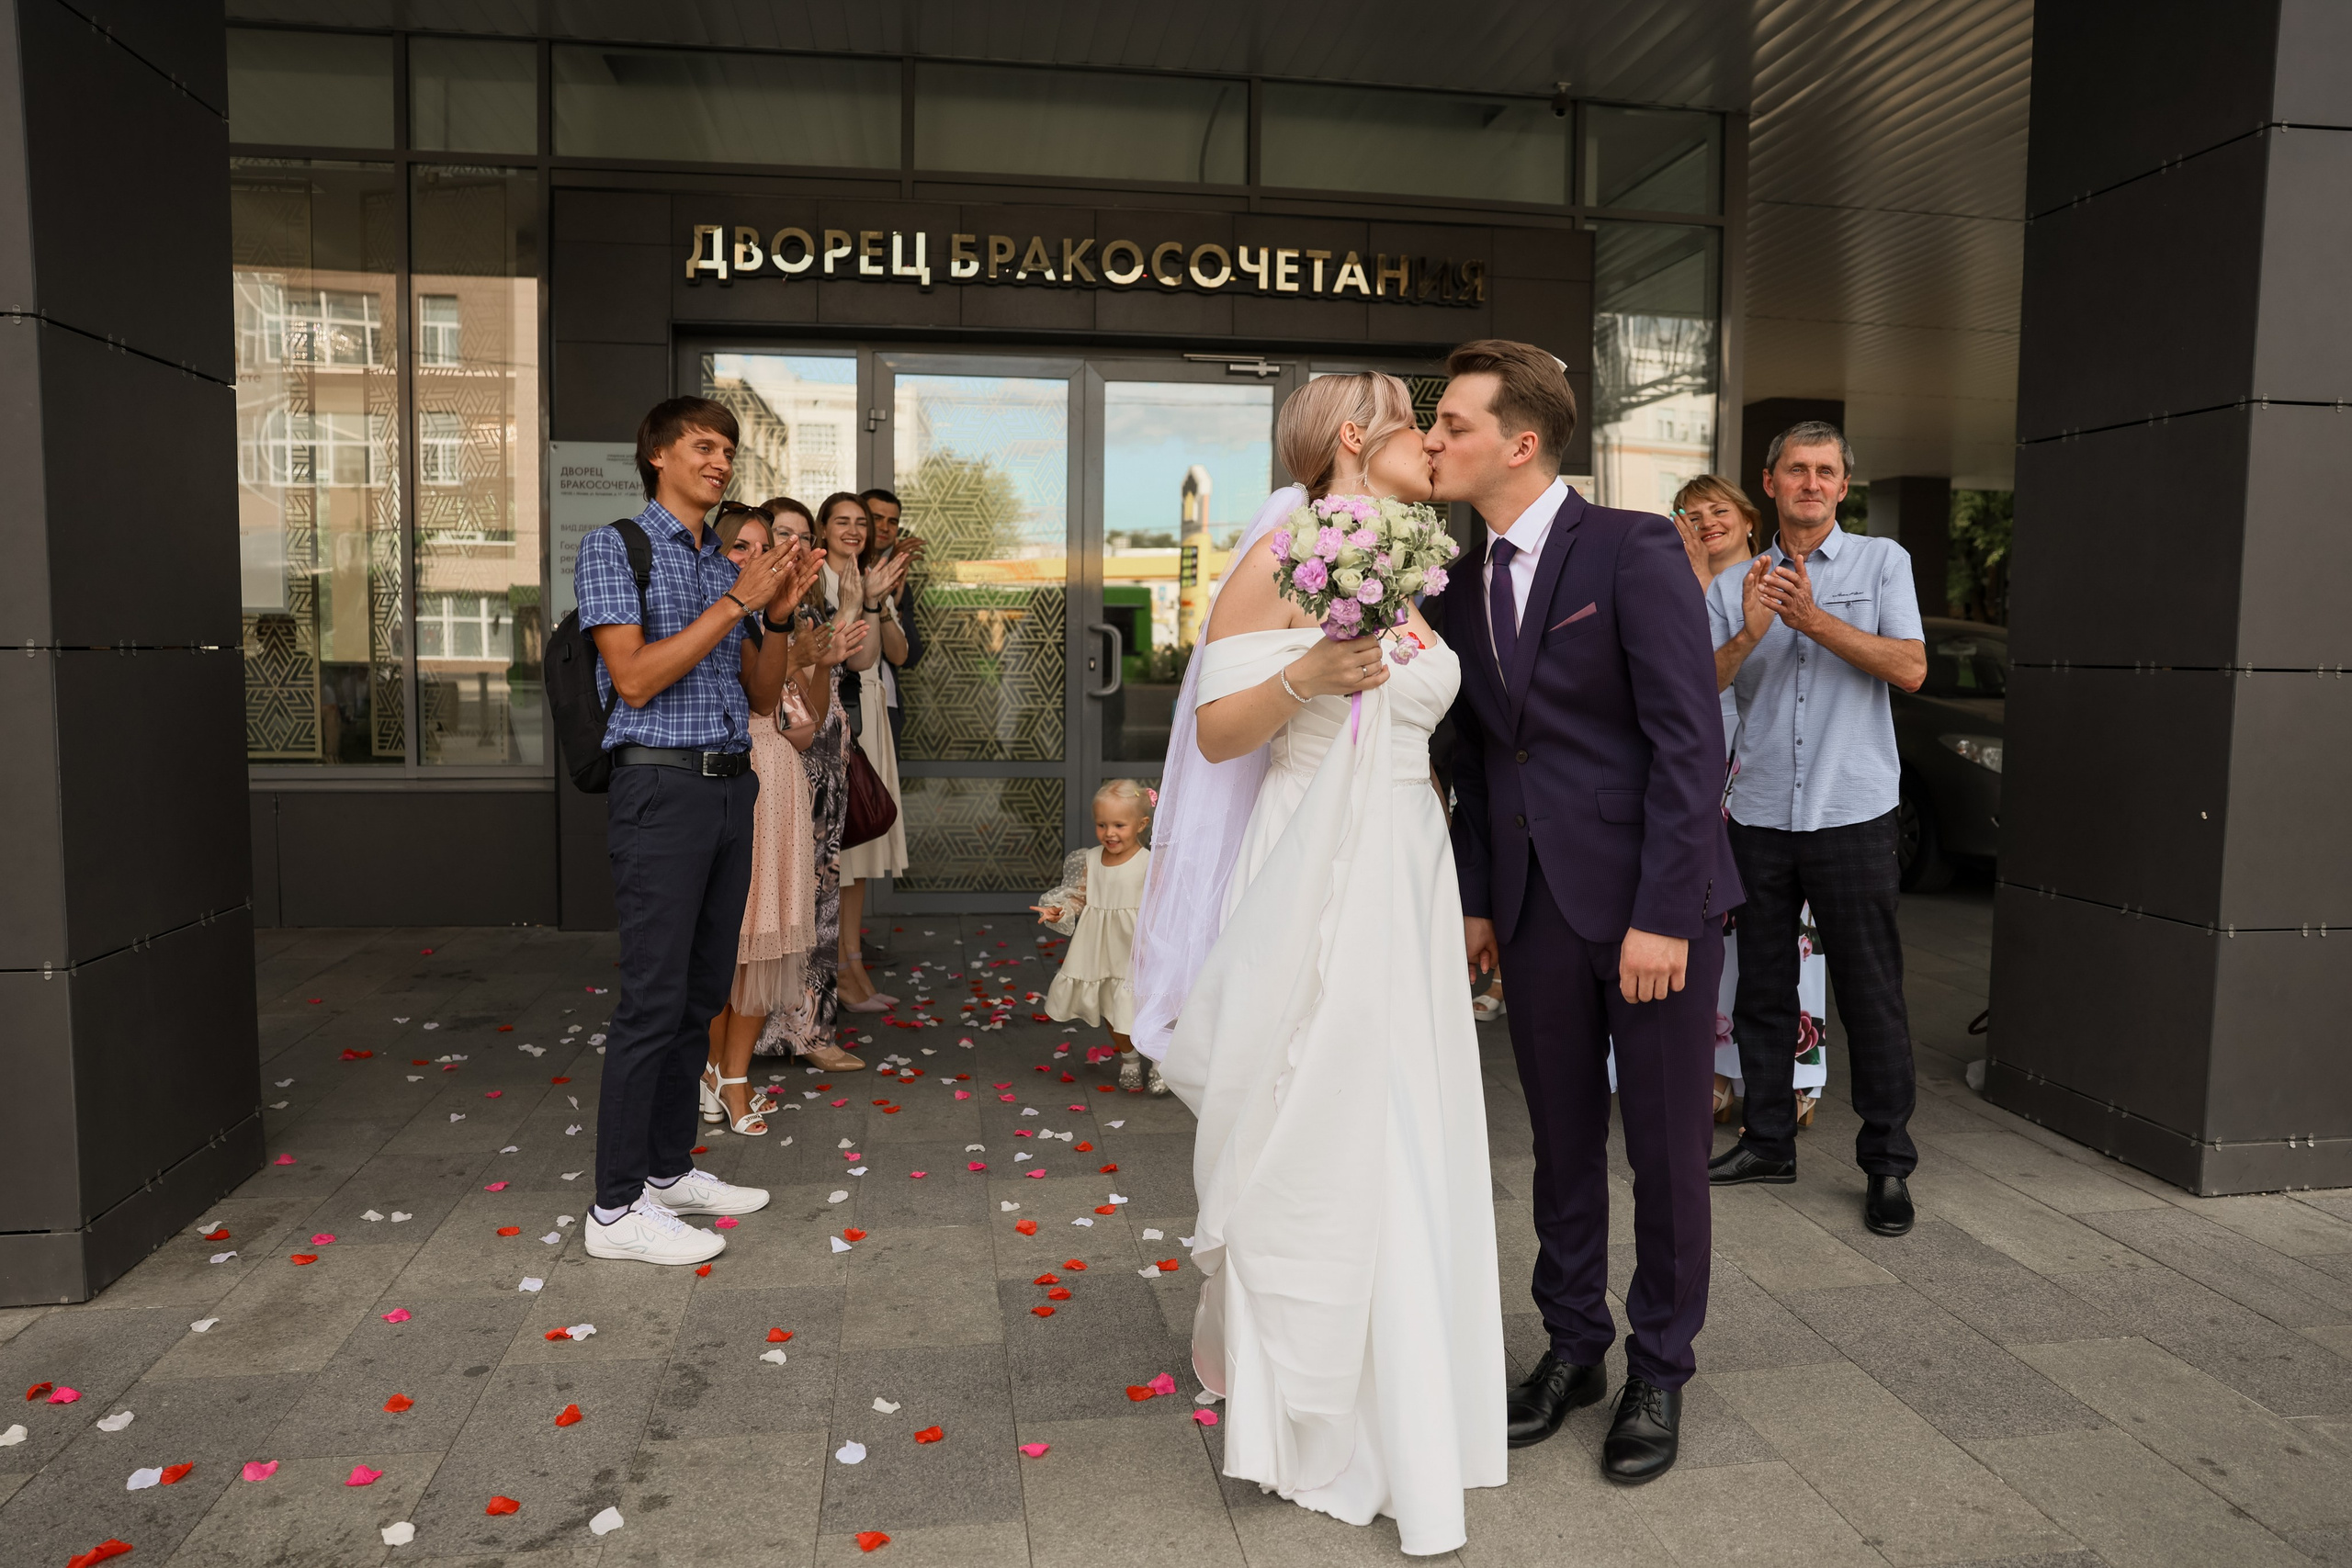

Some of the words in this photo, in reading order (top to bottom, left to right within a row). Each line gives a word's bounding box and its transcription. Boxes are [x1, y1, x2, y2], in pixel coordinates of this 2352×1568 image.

[685, 224, 931, 286] ДВОРЕЦ
[950, 233, 1486, 301] БРАКОСОЧЕТАНИЯ
[235, 374, 261, 383] сте
[560, 467, 603, 477] ДВОРЕЦ
[560, 479, 643, 490] БРАКОСОЧЕТАН
[560, 524, 577, 532] ВИД
[560, 541, 581, 552] Госу
